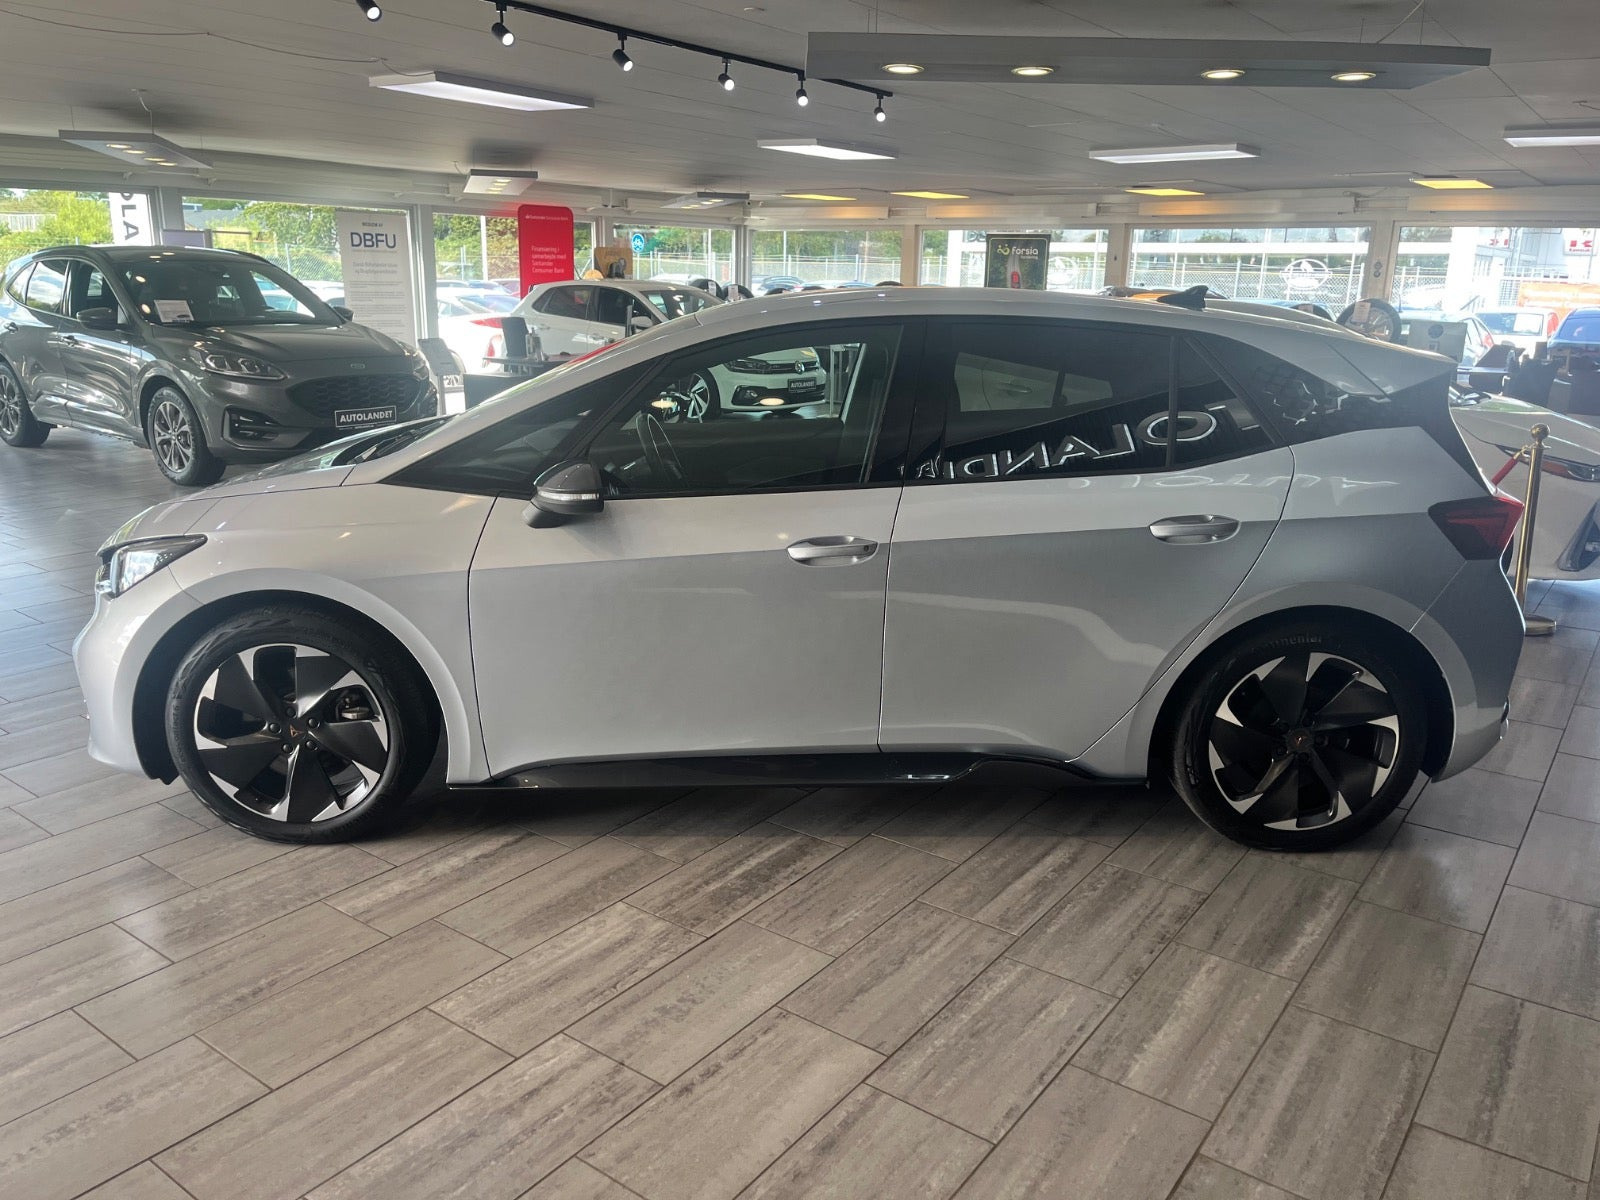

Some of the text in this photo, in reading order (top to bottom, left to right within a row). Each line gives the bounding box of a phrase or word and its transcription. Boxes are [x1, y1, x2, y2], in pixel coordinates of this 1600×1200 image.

[350, 232, 397, 249] DBFU
[1012, 246, 1039, 255] forsia
[340, 410, 393, 423] AUTOLANDET
